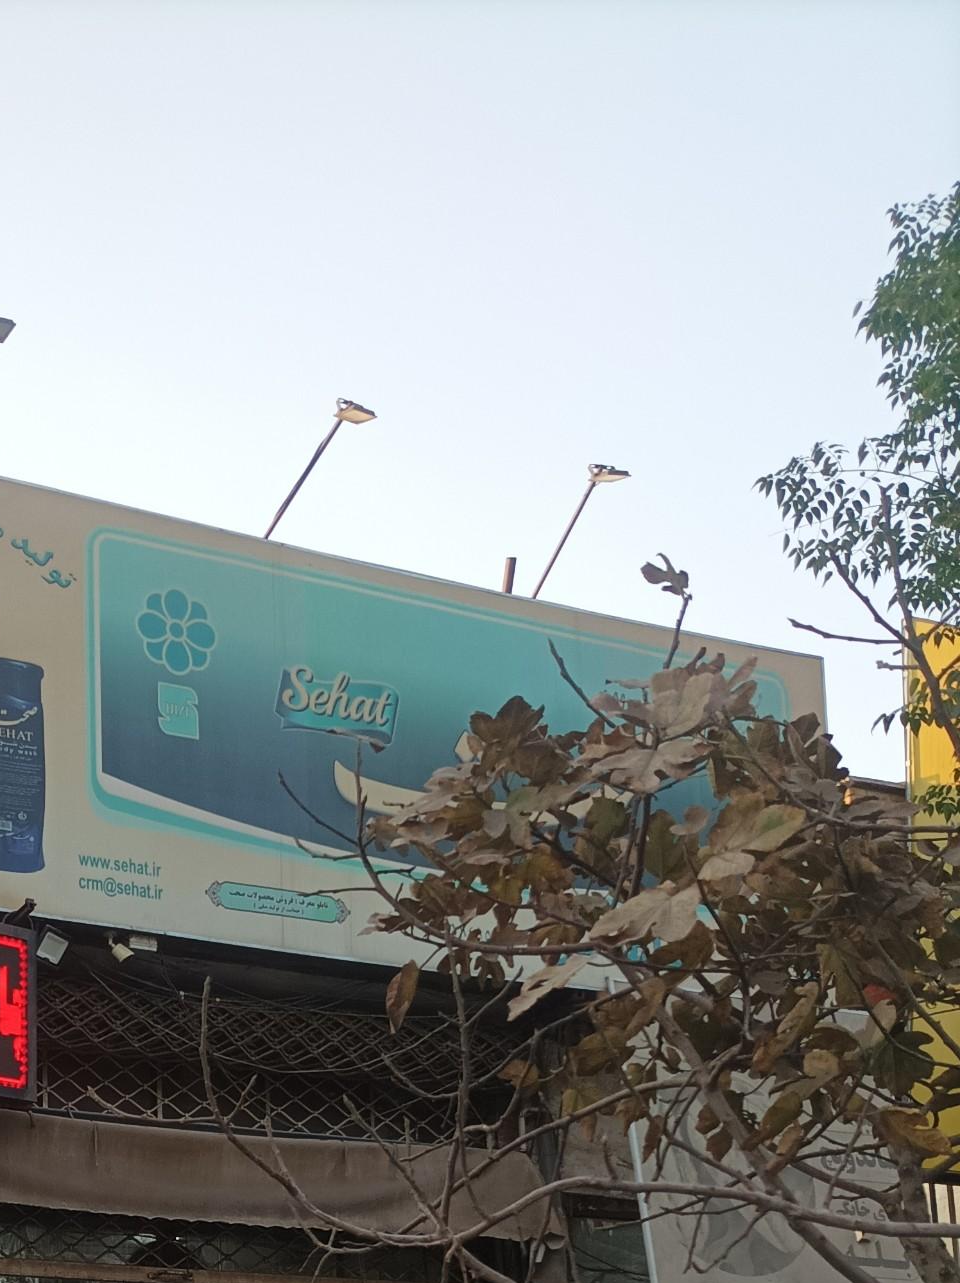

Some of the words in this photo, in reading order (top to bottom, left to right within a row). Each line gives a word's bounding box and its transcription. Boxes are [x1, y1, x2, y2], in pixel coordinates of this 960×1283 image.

[282, 666, 394, 727] Sehat
[78, 853, 162, 878] www.sehat.ir
[78, 876, 164, 900] crm@sehat.ir
